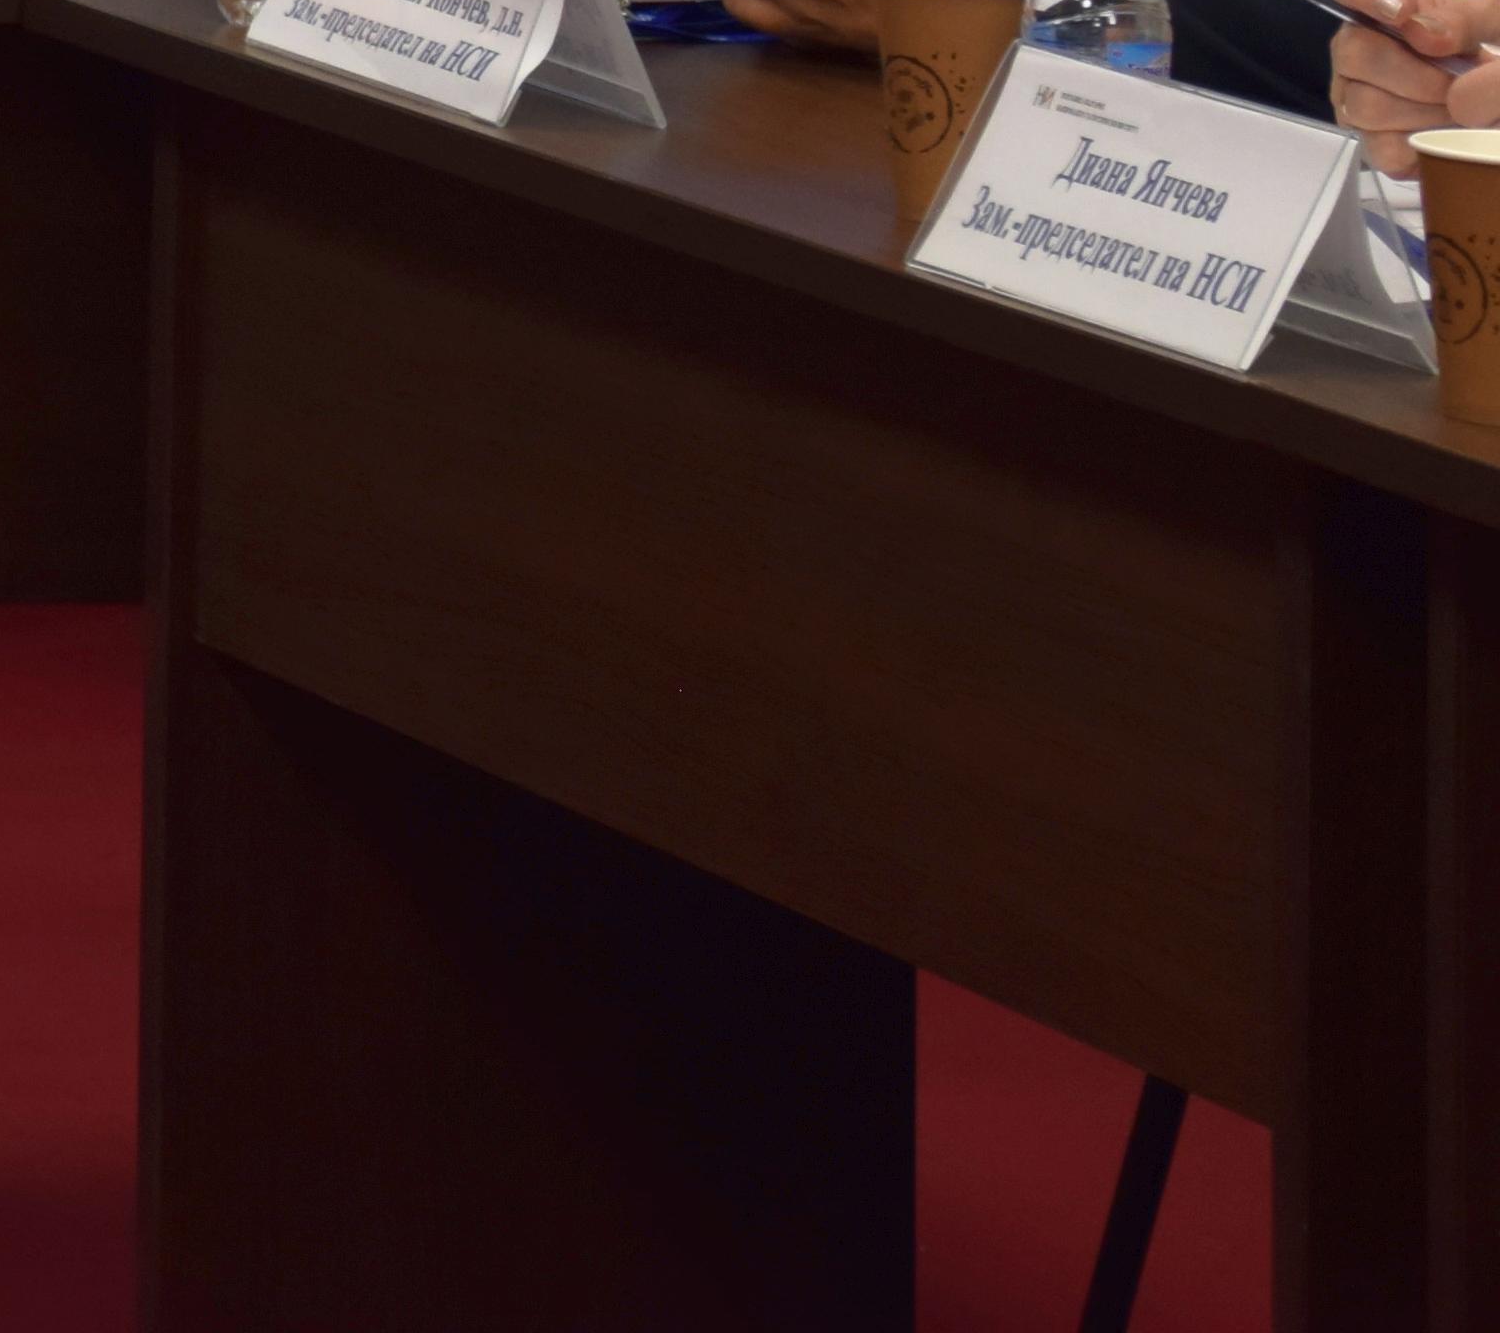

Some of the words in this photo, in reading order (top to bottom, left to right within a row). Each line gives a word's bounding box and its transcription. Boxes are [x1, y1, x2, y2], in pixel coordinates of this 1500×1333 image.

[418, 35, 447, 66] на
[440, 40, 500, 82] НСИ
[1052, 135, 1138, 197] Диана
[1132, 158, 1229, 223] Янчева
[961, 185, 1160, 282] Зам.-председател
[1155, 254, 1192, 293] на
[1187, 252, 1267, 314] НСИ
